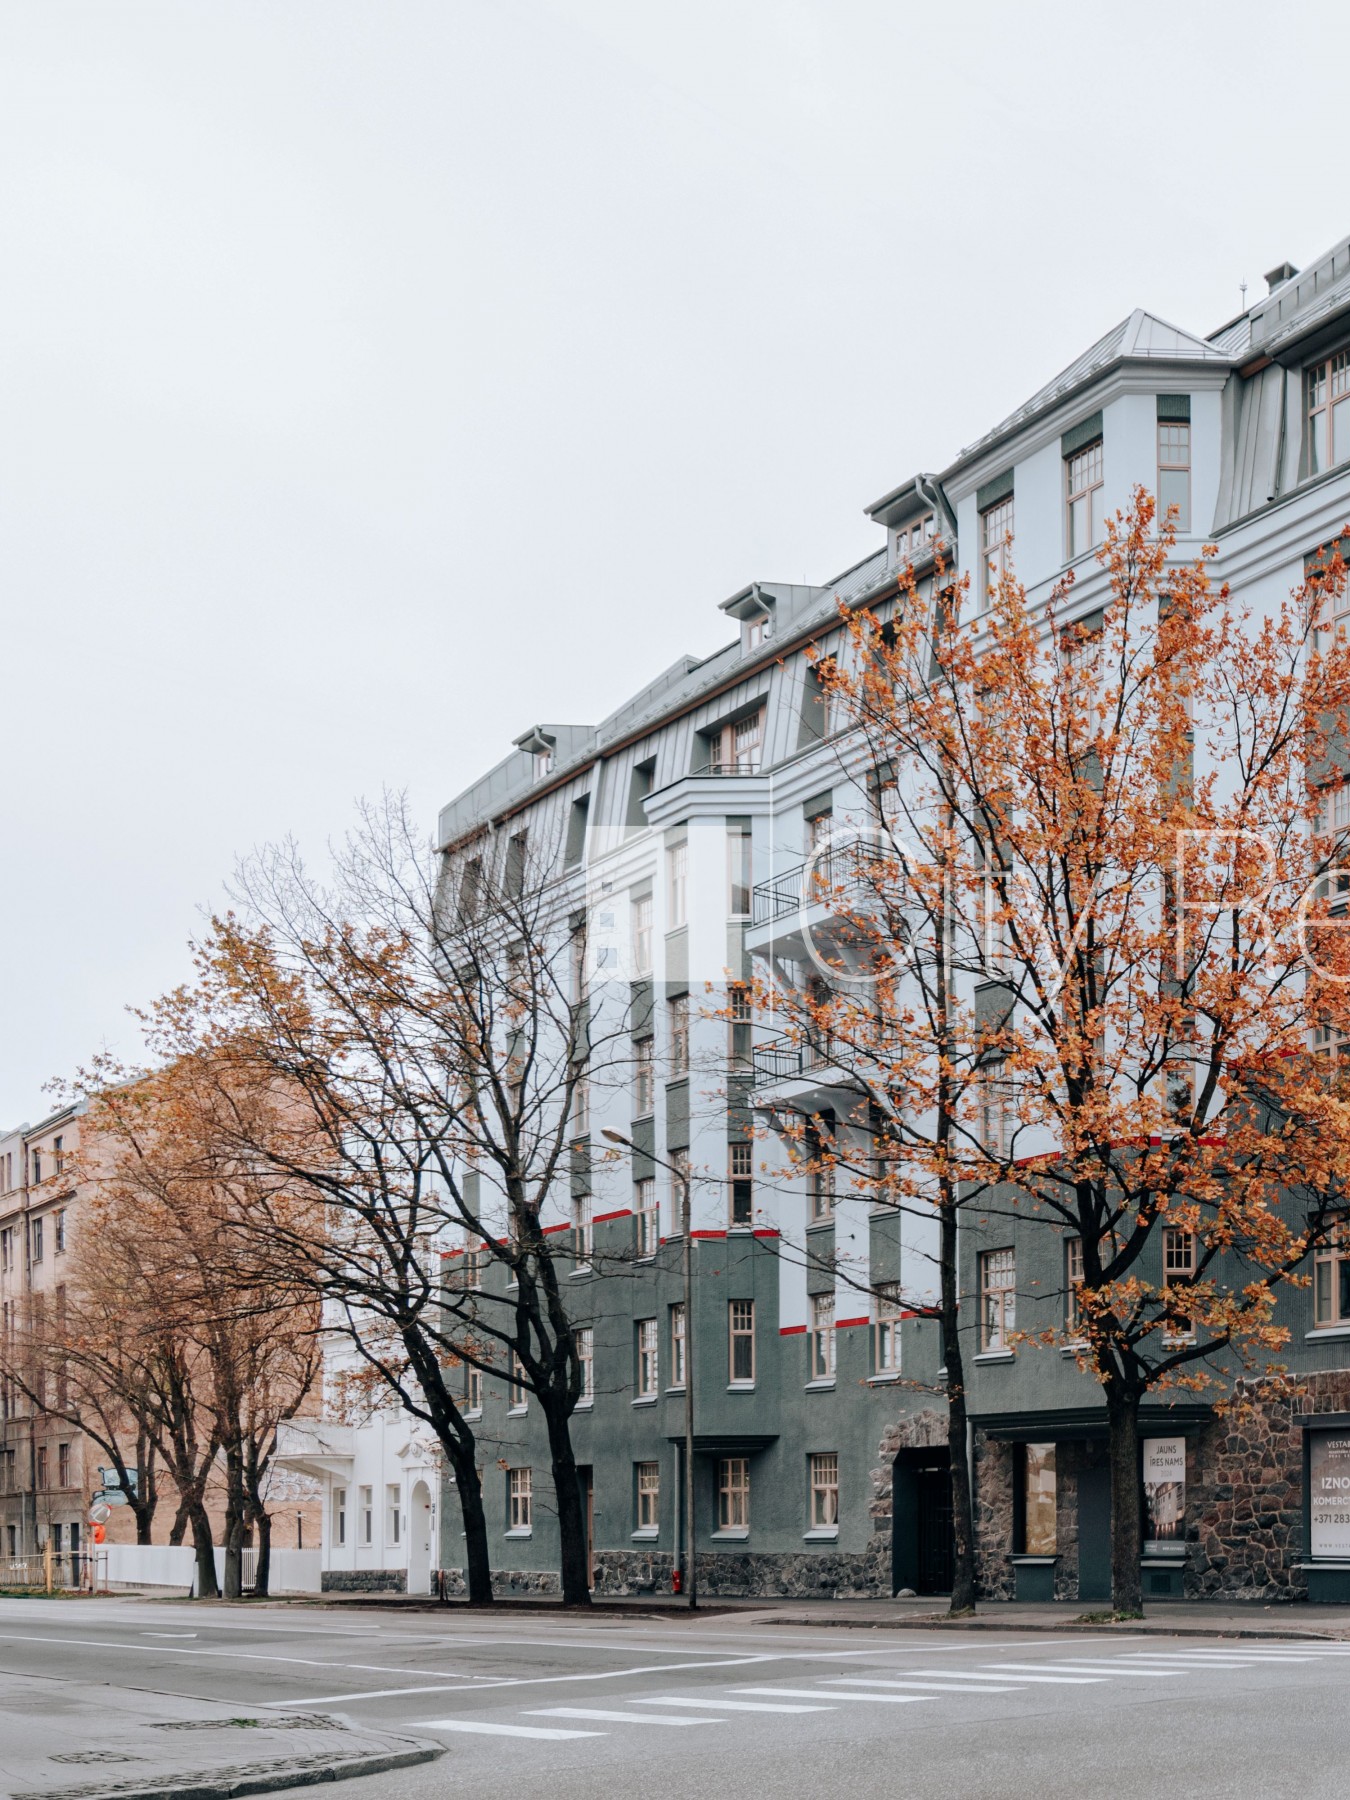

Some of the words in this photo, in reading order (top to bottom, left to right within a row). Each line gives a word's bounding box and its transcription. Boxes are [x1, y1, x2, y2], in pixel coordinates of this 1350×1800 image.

[1156, 1445, 1177, 1455] JAUNS
[1165, 1457, 1184, 1467] NAMS
[1313, 1514, 1332, 1524] +371
